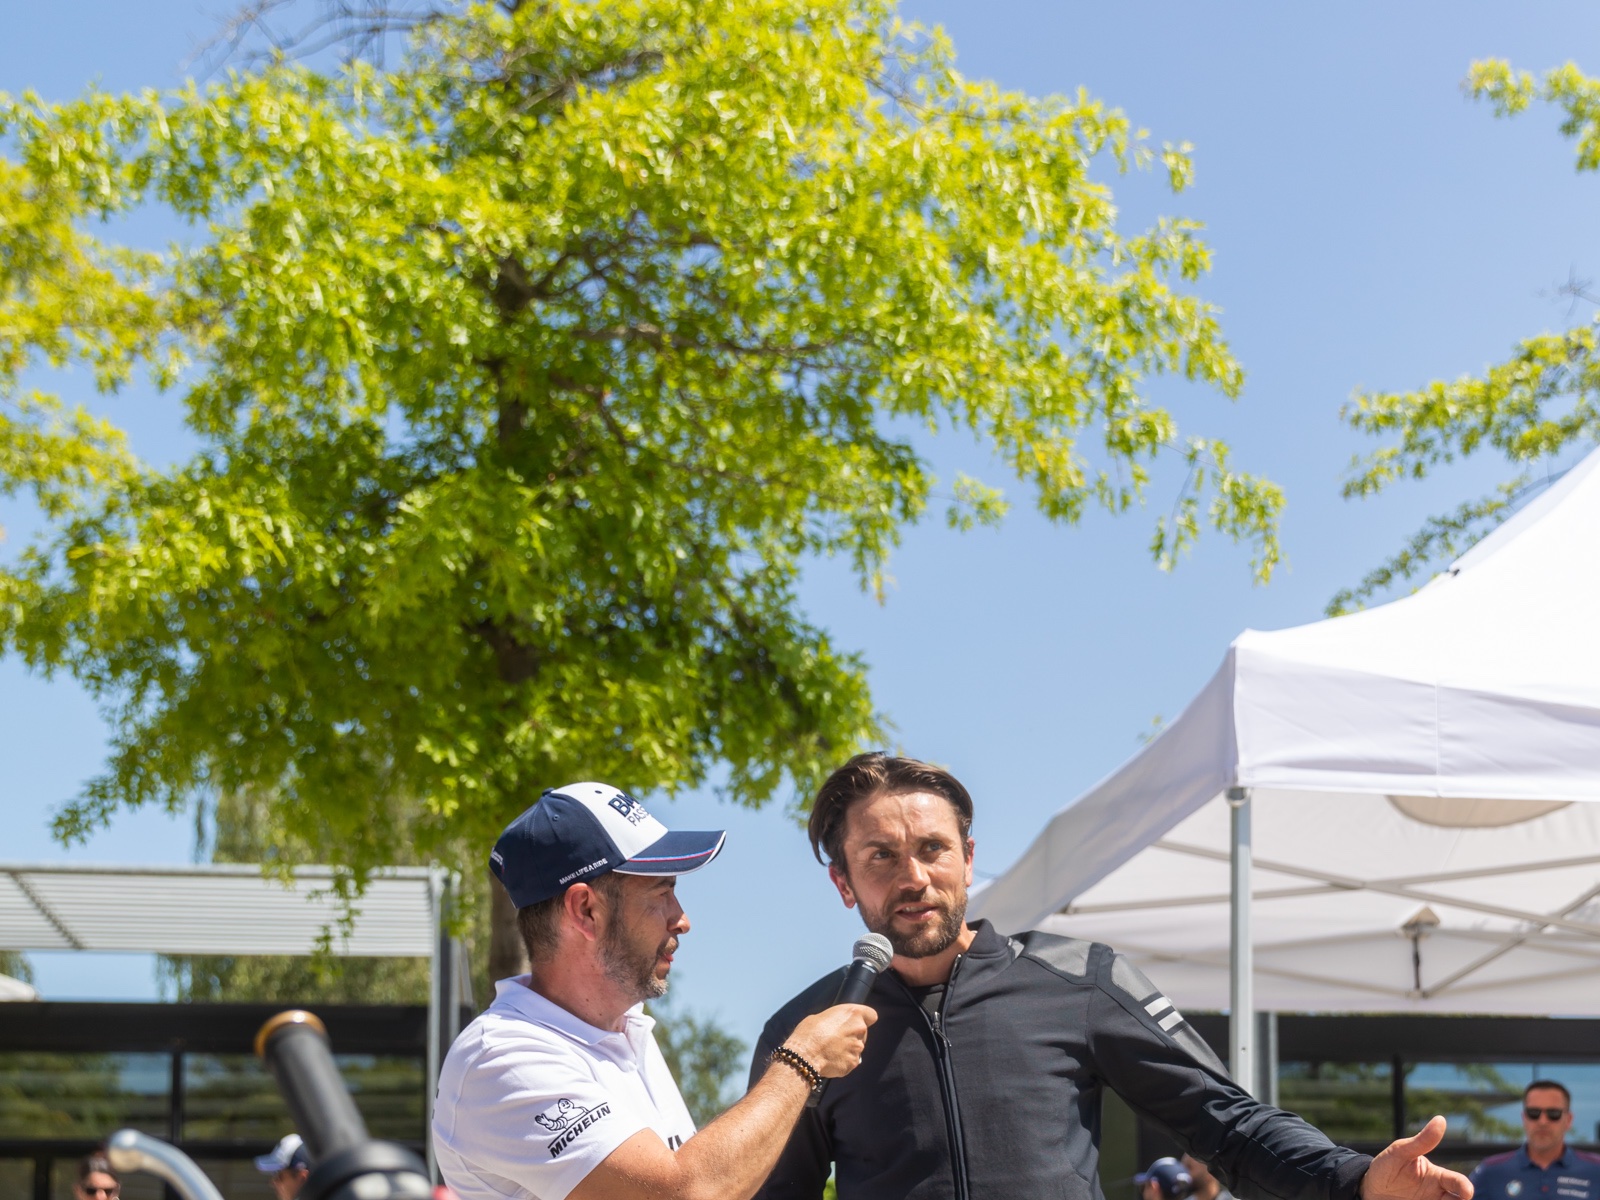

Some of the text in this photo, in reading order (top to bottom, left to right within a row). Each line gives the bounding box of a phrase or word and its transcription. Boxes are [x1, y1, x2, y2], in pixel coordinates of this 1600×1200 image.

[559, 872, 576, 885] MAKE
[575, 866, 589, 877] LIFE
[592, 857, 608, 869] RIDE
[549, 1104, 612, 1159] MICHELIN
